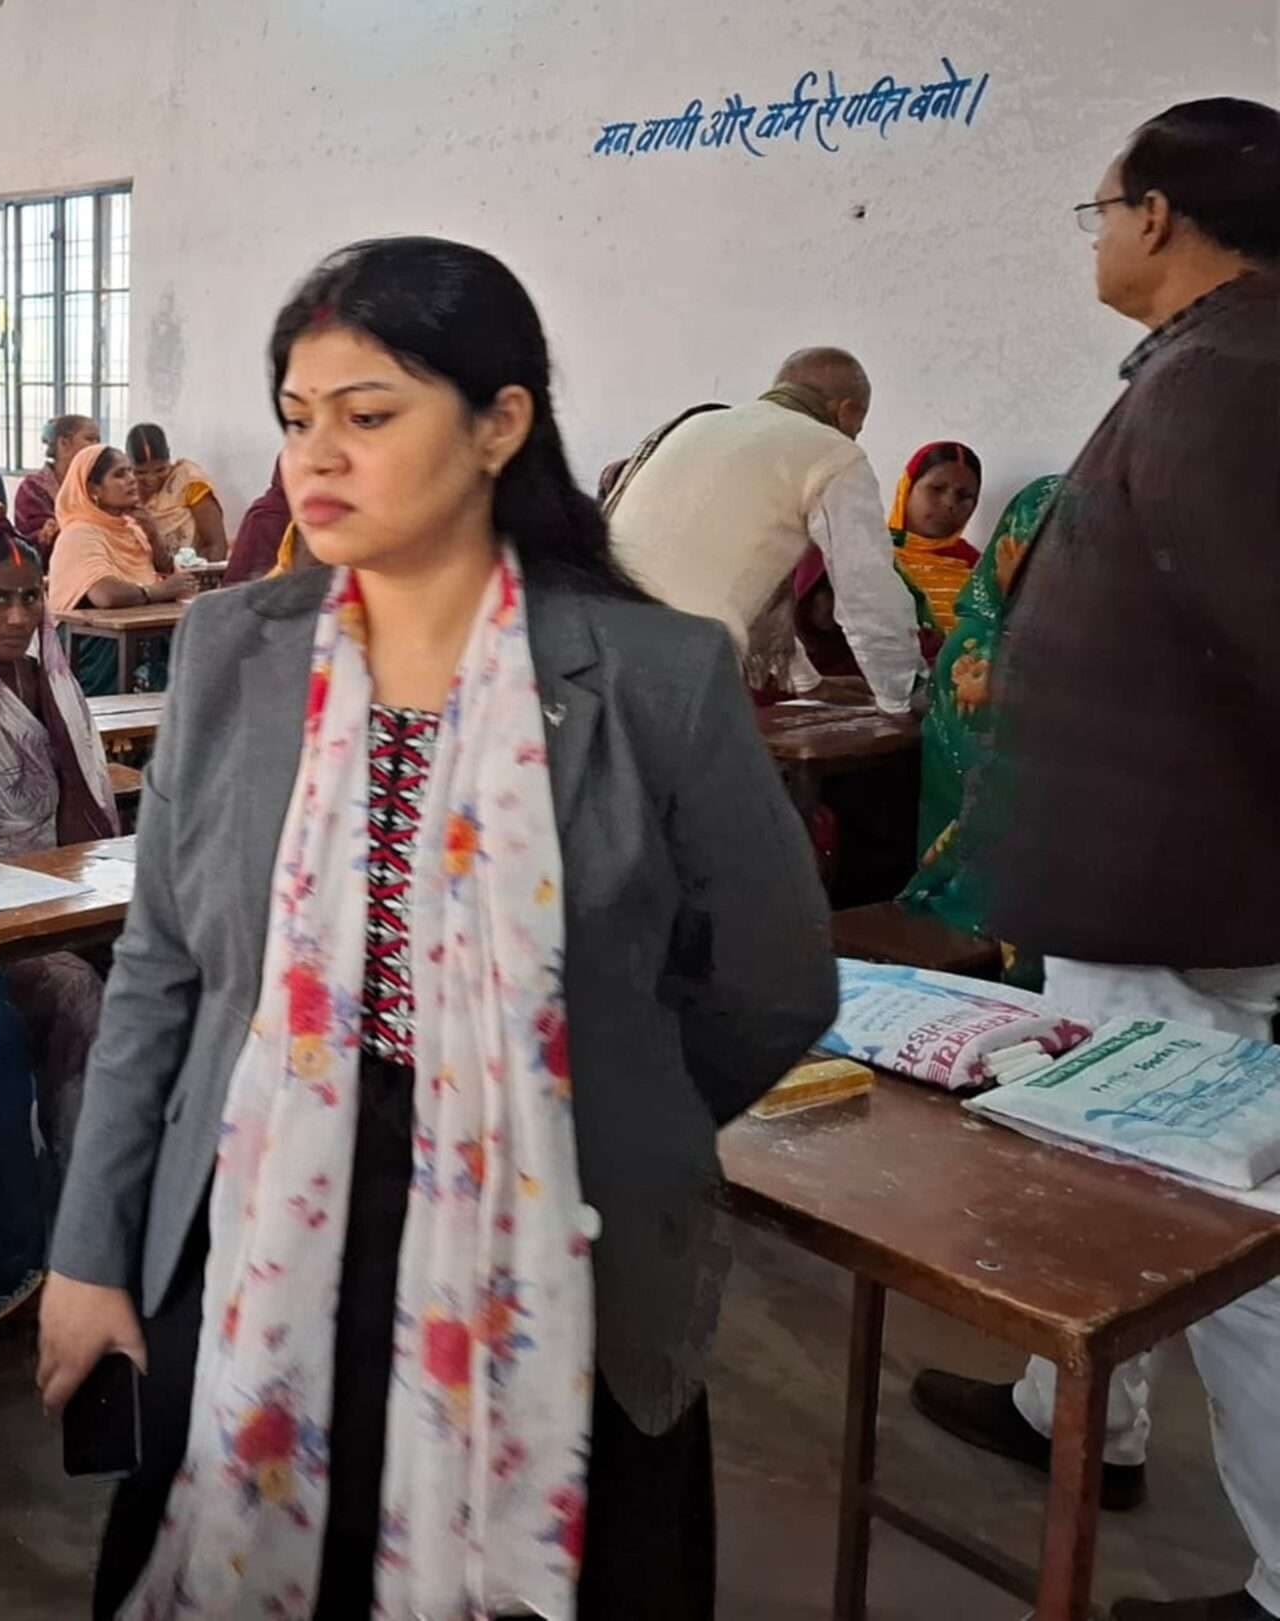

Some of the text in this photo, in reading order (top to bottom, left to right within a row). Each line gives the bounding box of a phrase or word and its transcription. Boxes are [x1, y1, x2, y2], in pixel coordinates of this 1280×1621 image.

[635, 99, 705, 153] वाणी
[700, 93, 767, 157] और
[756, 71, 818, 140] कर्म
[815, 70, 840, 153] से
